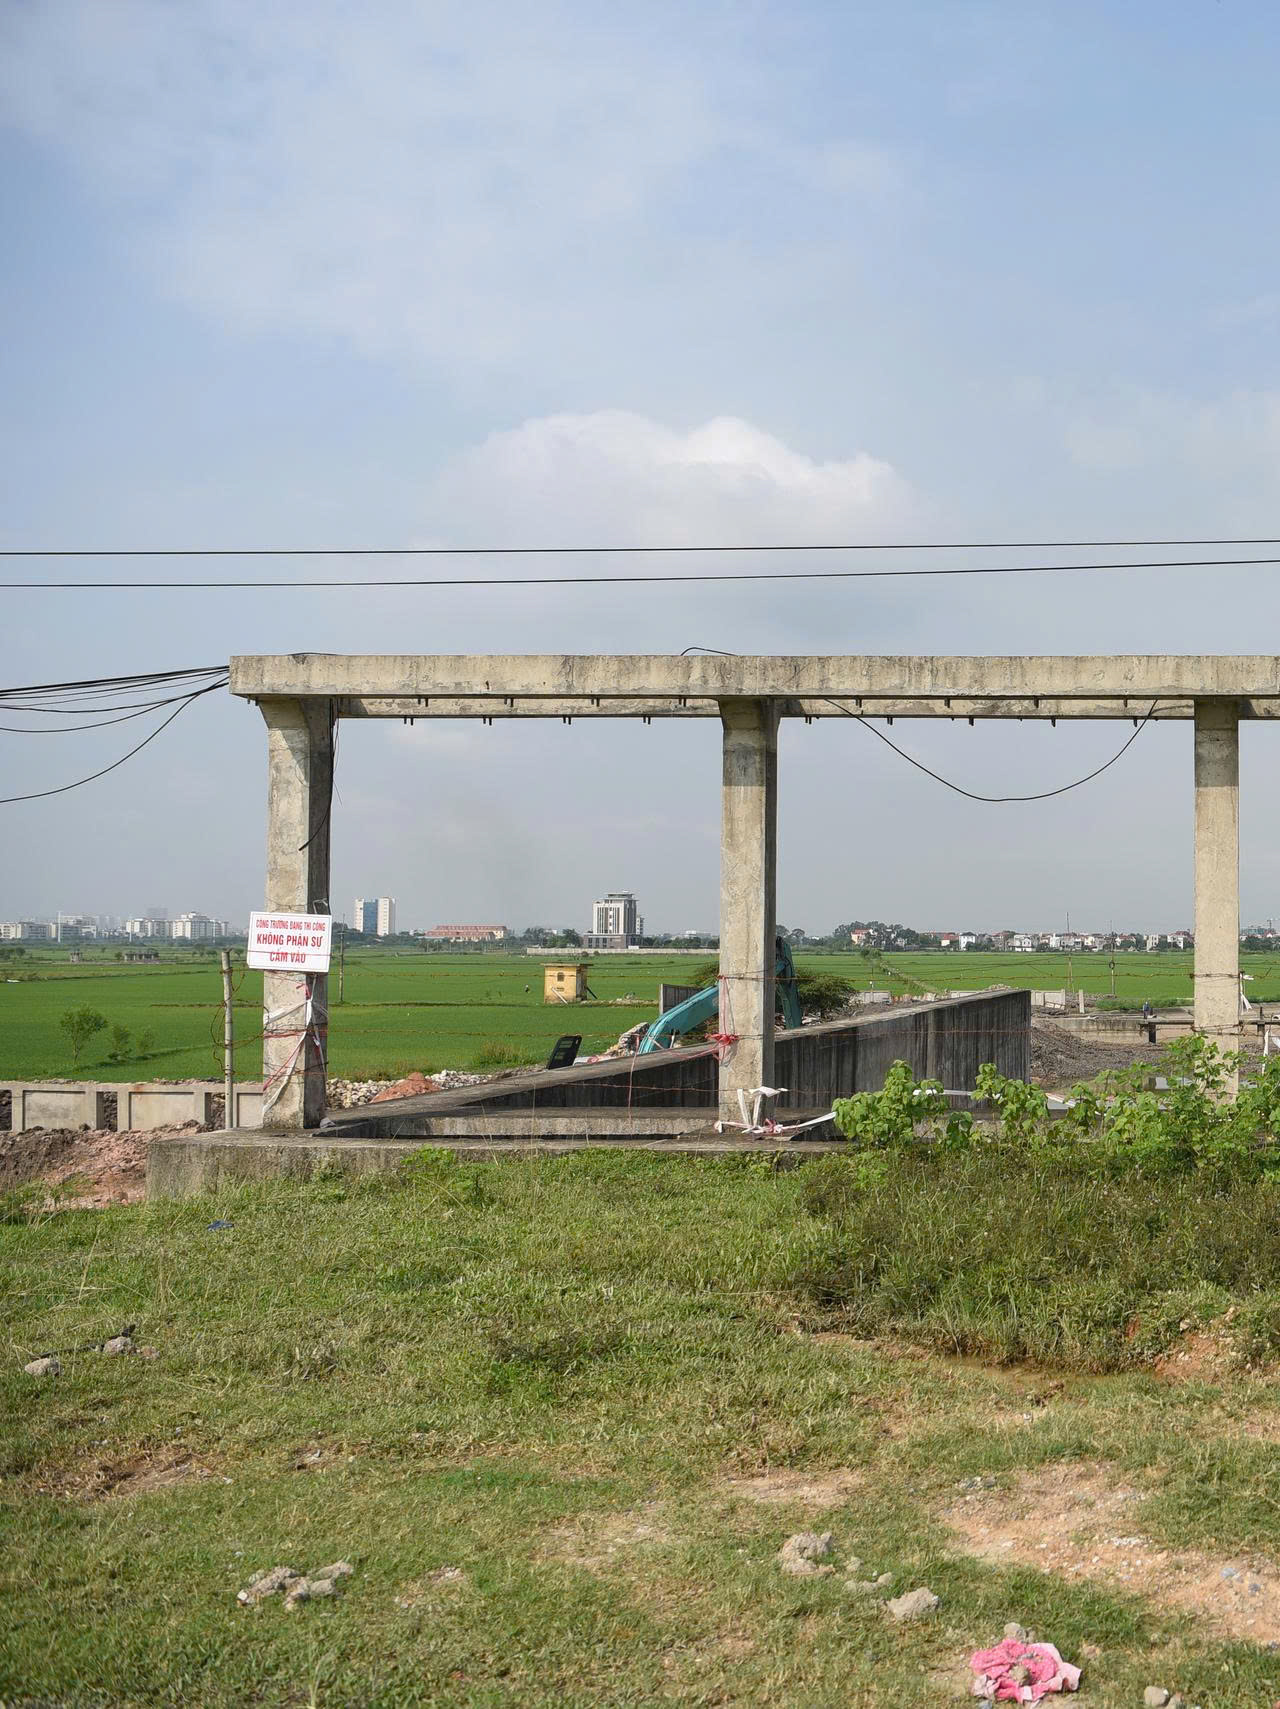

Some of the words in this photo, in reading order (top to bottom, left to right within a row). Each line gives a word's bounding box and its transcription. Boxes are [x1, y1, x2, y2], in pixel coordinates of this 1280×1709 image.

[256, 919, 270, 928] CÔNG
[270, 918, 288, 929] TRƯỜNG
[290, 920, 302, 930] ĐANG
[312, 921, 325, 931] CÔNG
[256, 932, 284, 945] KHÔNG
[286, 933, 308, 949] PHẬN
[311, 936, 323, 950] SỰ
[270, 948, 288, 962] CẤM
[291, 950, 306, 963] VÀO
